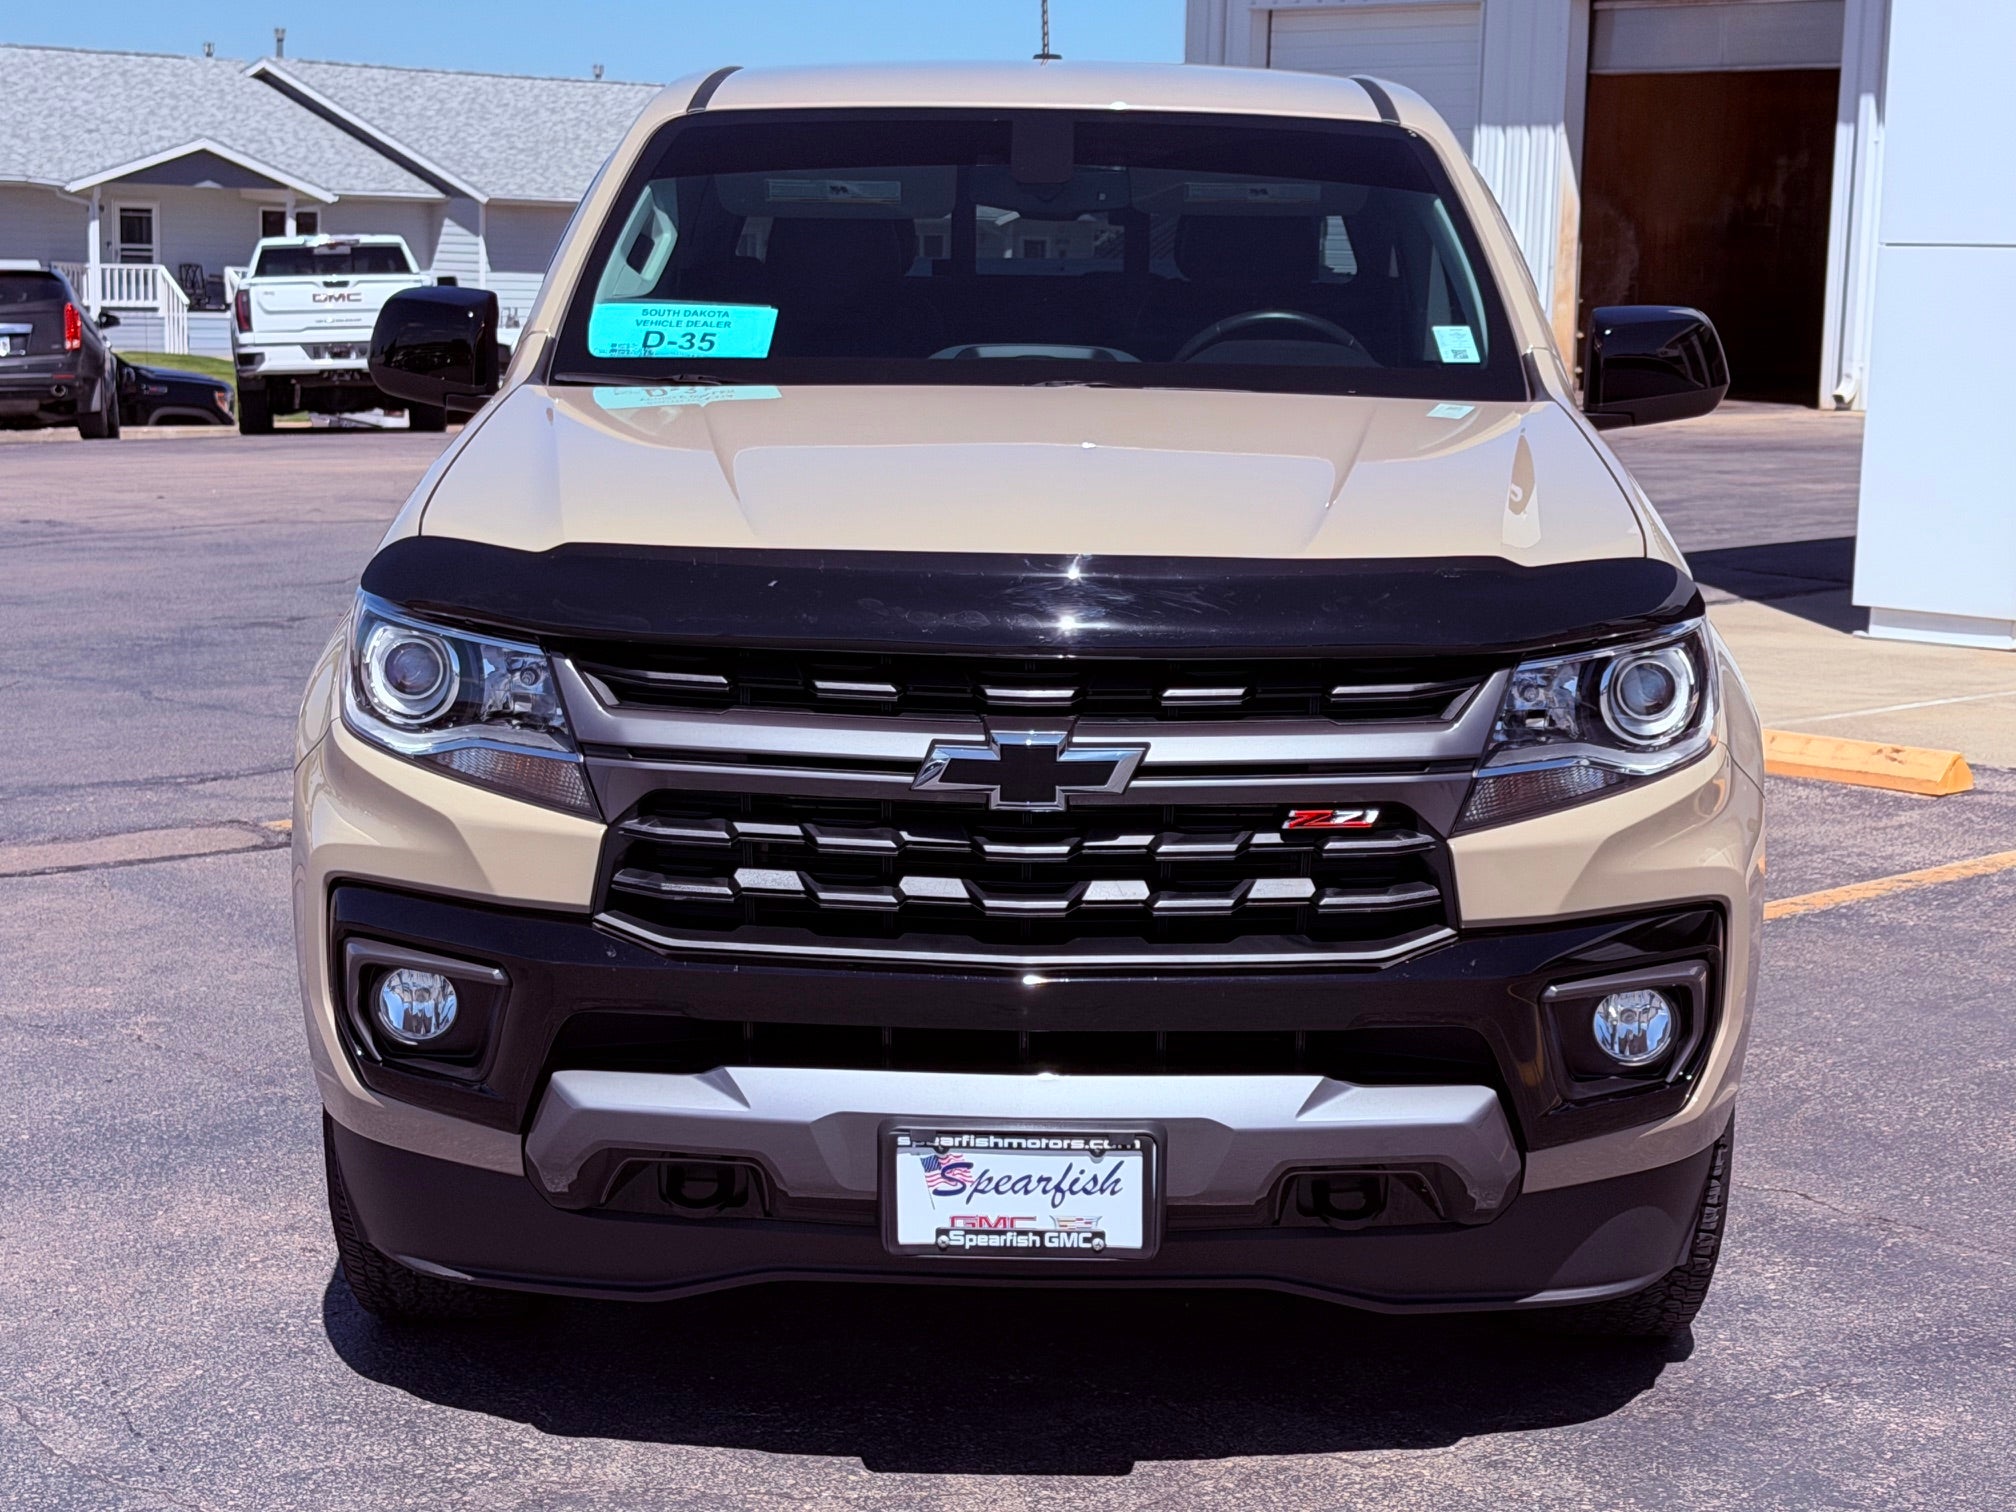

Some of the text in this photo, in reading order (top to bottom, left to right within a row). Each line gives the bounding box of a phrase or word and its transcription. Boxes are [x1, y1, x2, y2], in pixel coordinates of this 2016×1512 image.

[312, 293, 362, 303] GMC
[641, 308, 730, 318] SOUTH DAKOTA
[635, 319, 732, 329] VEHICLE DEALER
[641, 330, 717, 352] D-35
[1282, 809, 1380, 829] Z71
[932, 1159, 1125, 1209] Spearfish
[950, 1215, 1037, 1229] GMC
[949, 1230, 1093, 1249] Spearfish GMC
